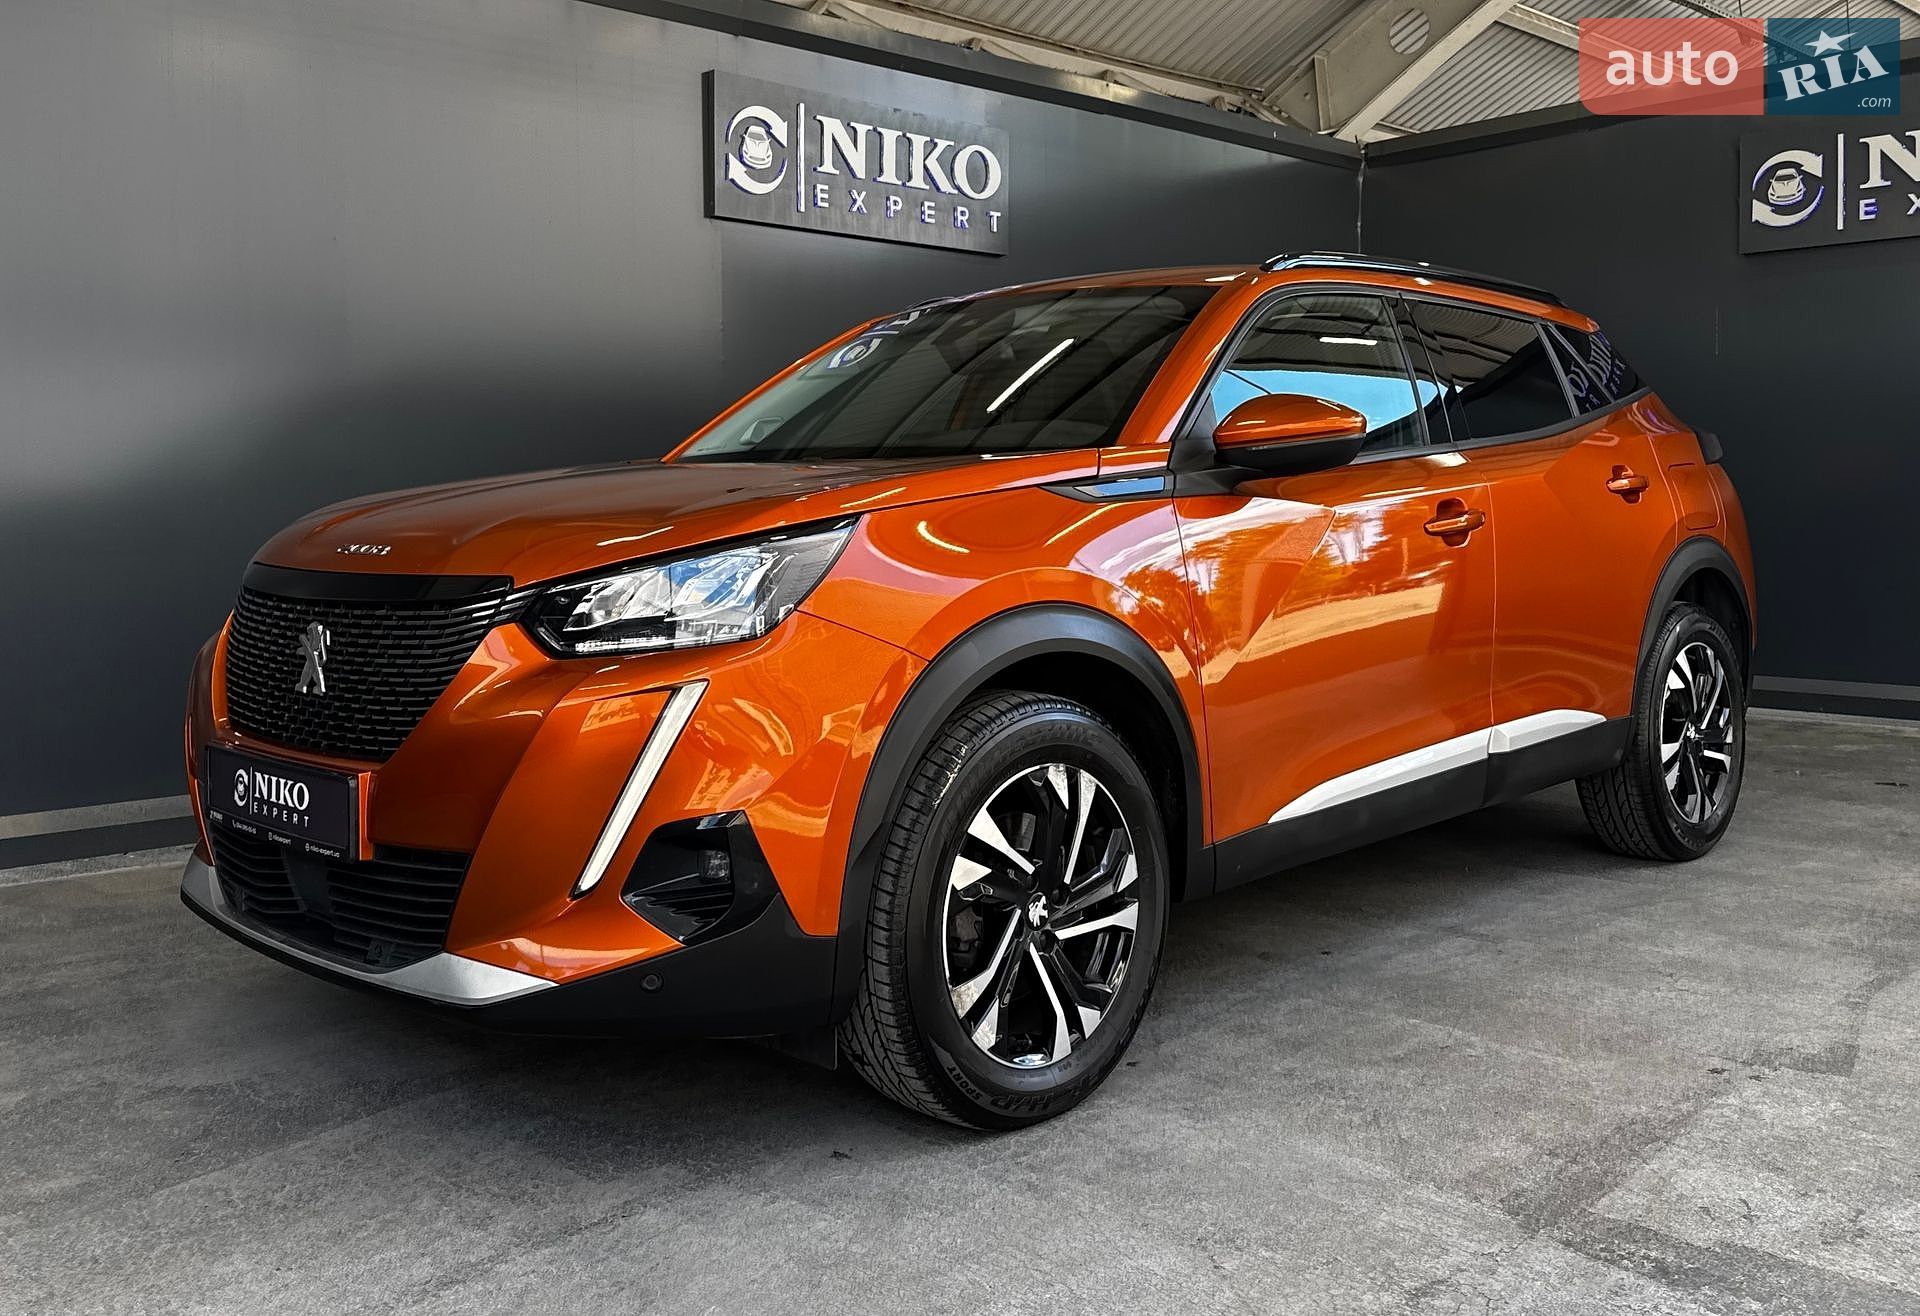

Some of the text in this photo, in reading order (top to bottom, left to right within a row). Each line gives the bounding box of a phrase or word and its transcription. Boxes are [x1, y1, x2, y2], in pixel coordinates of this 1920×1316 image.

[813, 114, 1002, 201] NIKO
[813, 183, 1002, 233] EXPERT
[254, 771, 309, 811] NIKO
[253, 801, 309, 828] EXPERT
